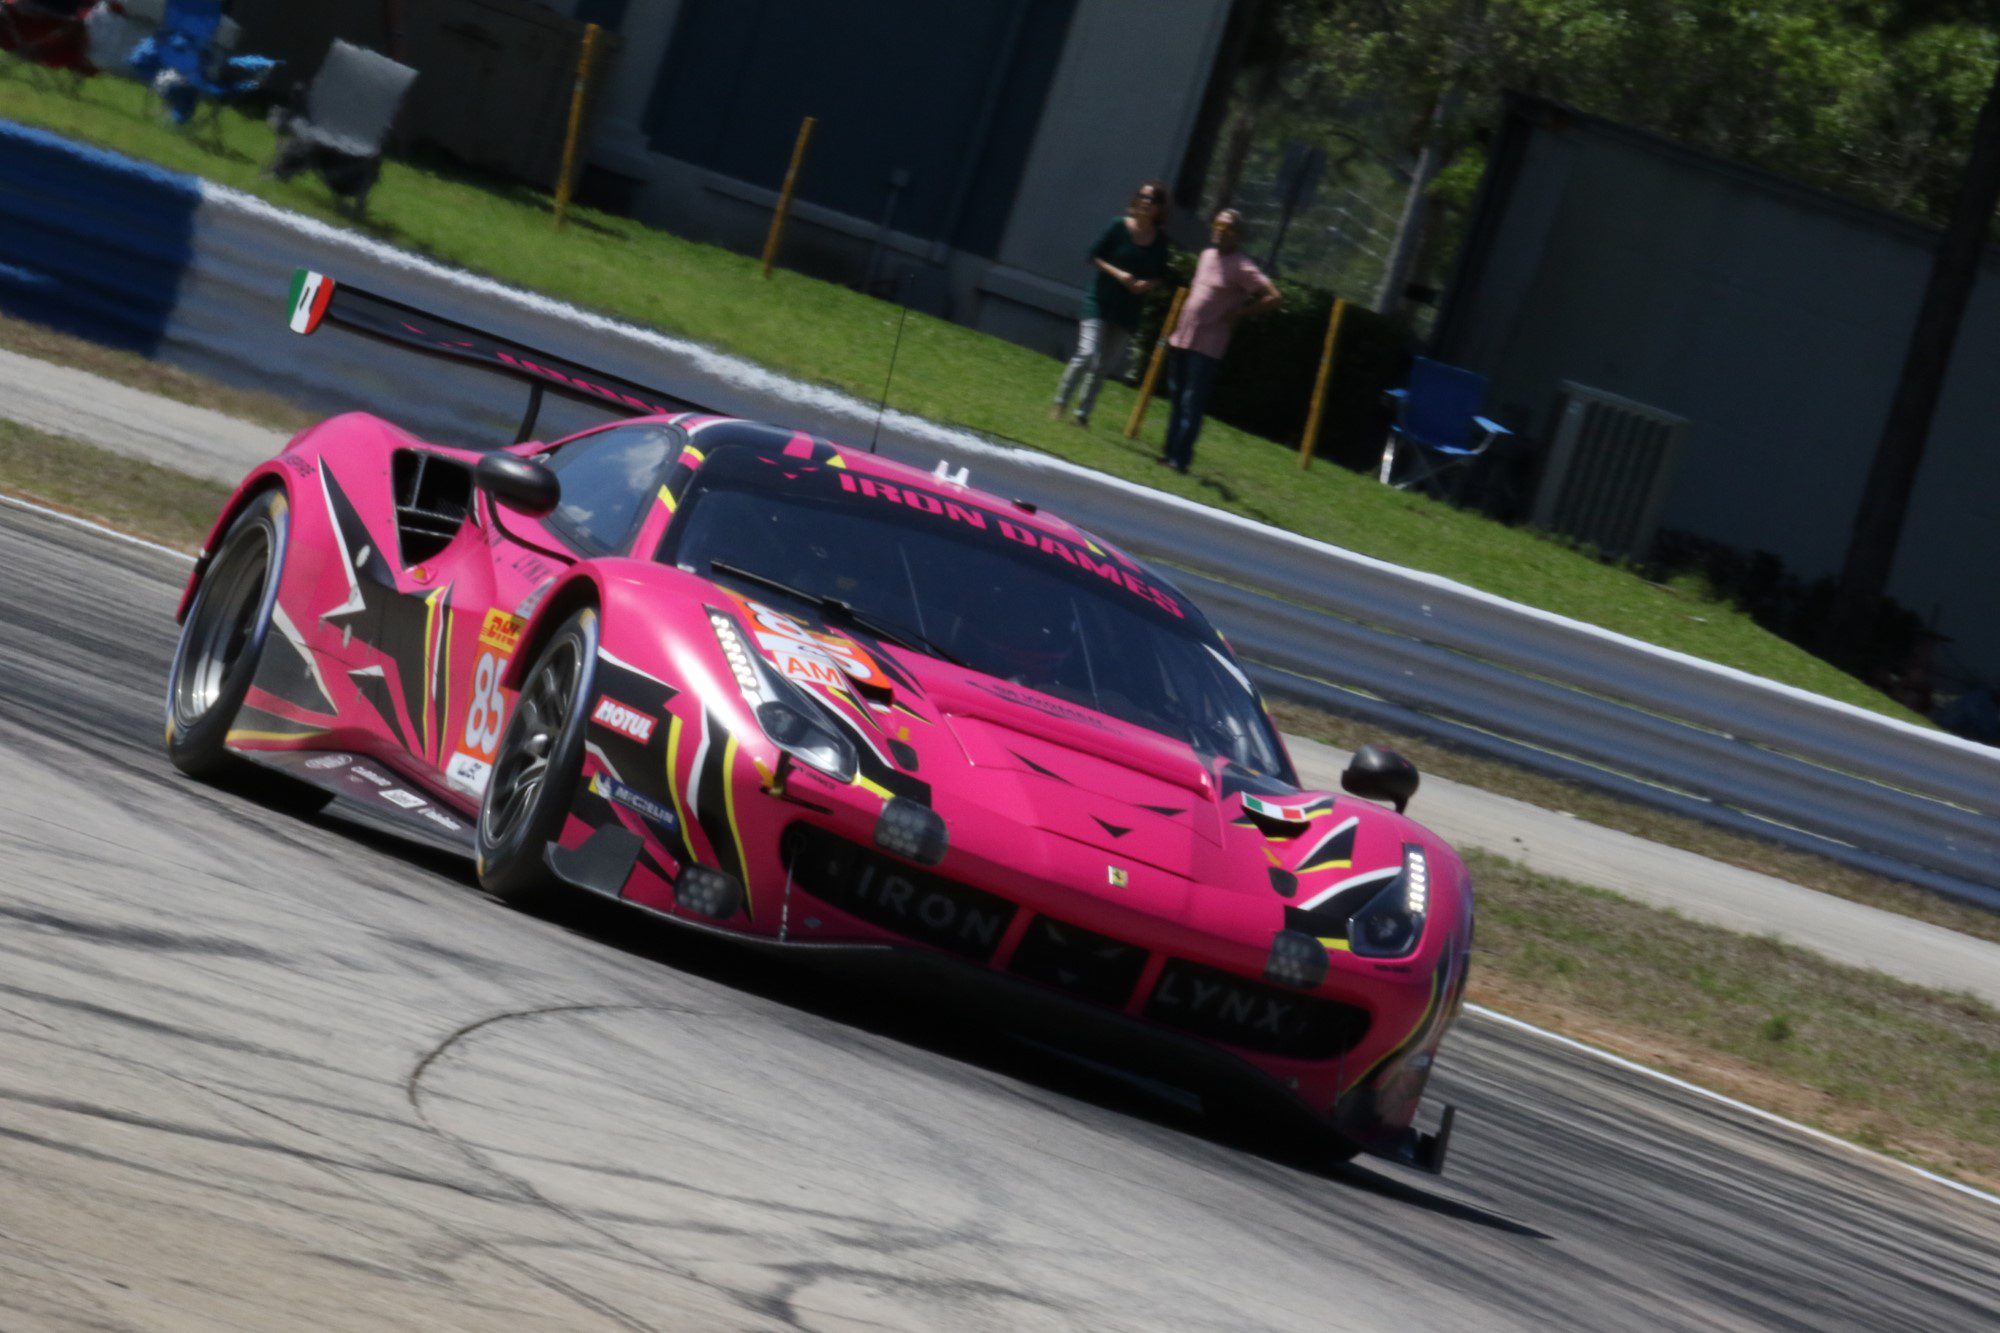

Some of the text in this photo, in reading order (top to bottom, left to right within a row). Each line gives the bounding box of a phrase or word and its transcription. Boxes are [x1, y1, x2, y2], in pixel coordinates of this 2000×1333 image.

[839, 473, 1184, 619] IRON DAMES
[787, 656, 842, 687] AM
[465, 652, 508, 755] 85
[595, 700, 653, 740] MOTUL
[614, 786, 674, 824] MICHELIN
[857, 864, 1001, 944] IRON
[1155, 971, 1293, 1034] LYNX
